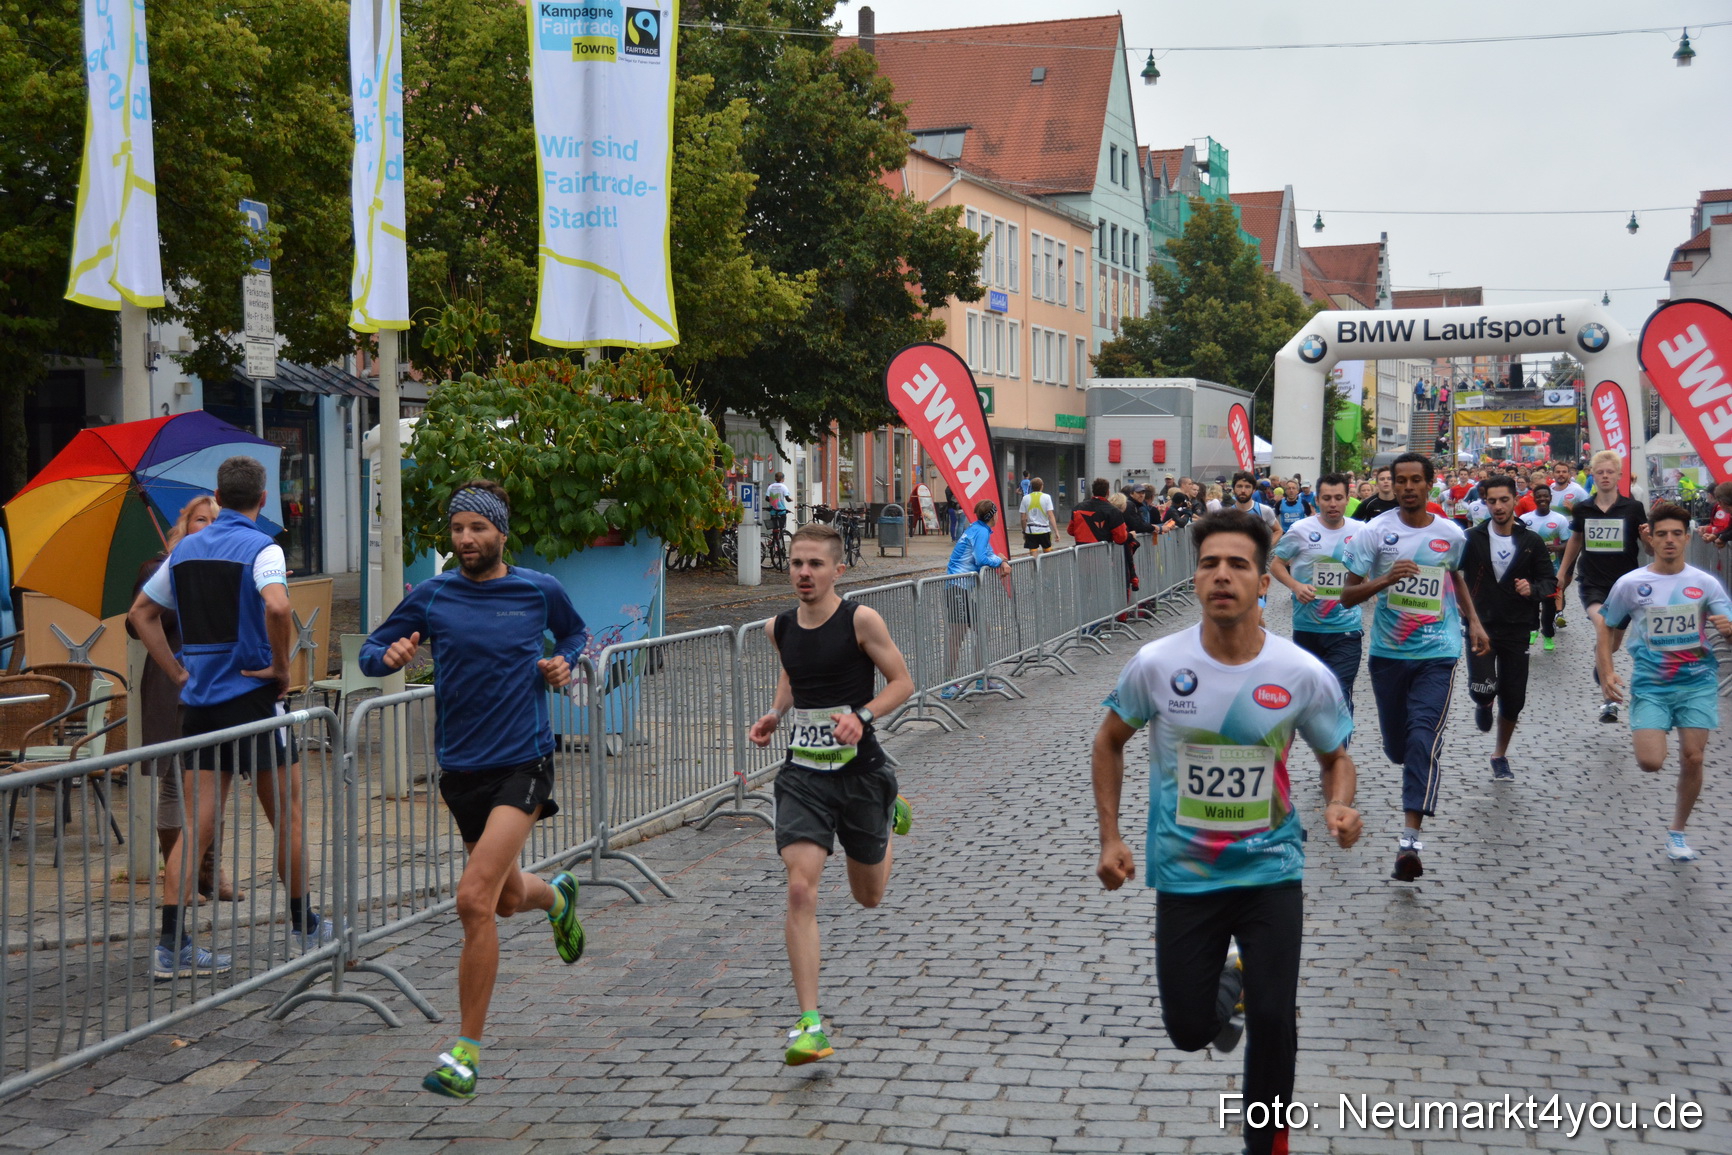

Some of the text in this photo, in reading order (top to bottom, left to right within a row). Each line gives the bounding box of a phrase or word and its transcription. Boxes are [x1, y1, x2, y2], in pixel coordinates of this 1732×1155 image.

[541, 4, 614, 20] Kampagne
[541, 18, 620, 36] Fairtrade
[574, 42, 615, 56] Towns
[626, 46, 659, 56] FAIRTRADE
[541, 134, 639, 162] Wir sind
[544, 170, 658, 197] Fairtrade-
[548, 205, 618, 229] Stadt!
[1337, 313, 1566, 343] BMW Laufsport
[1501, 412, 1530, 423] ZIEL
[1588, 526, 1620, 540] 5277
[1395, 576, 1440, 597] 5250
[1401, 598, 1428, 608] Mahadi
[1653, 613, 1696, 634] 2734
[1168, 700, 1197, 709] PARTL
[1168, 707, 1197, 715] Neumarkt
[799, 724, 847, 747] 525
[1220, 748, 1266, 759] BOCK
[1188, 764, 1265, 798] 5237
[1204, 805, 1245, 819] Wahid
